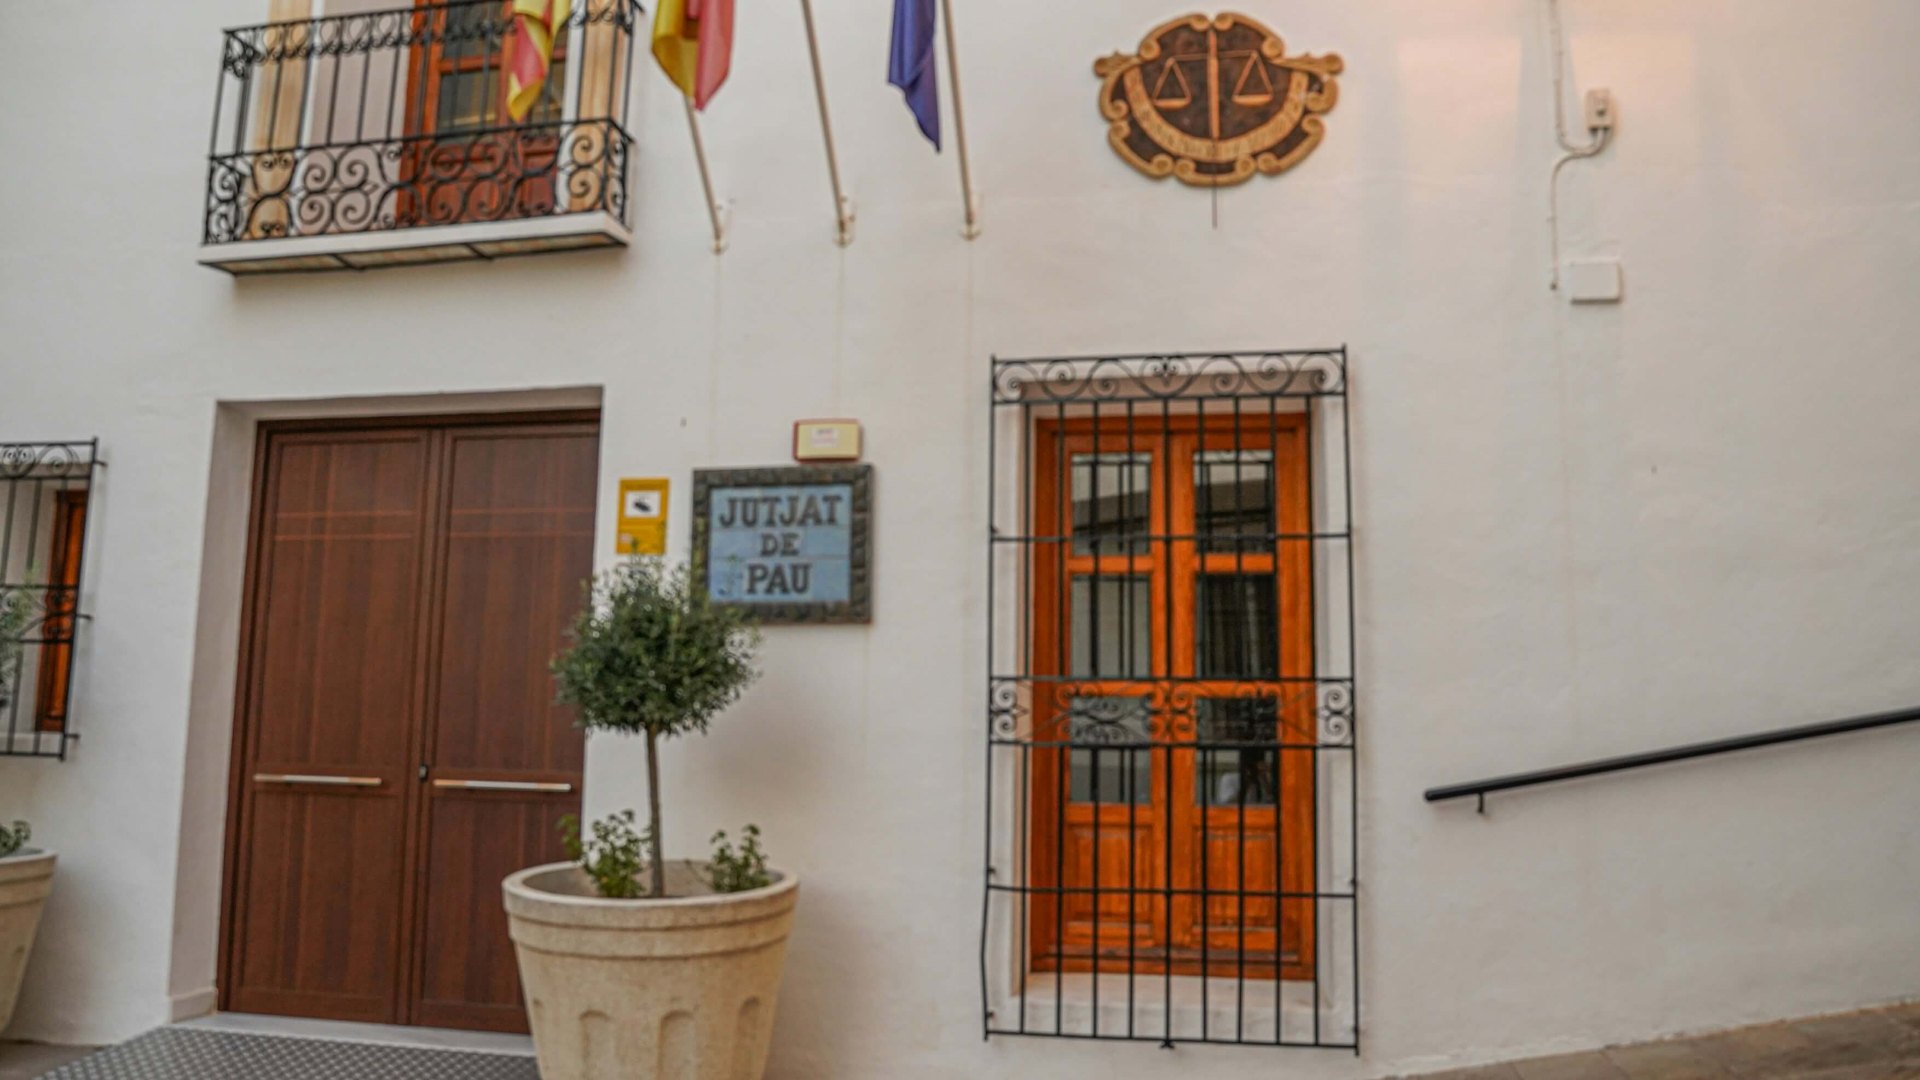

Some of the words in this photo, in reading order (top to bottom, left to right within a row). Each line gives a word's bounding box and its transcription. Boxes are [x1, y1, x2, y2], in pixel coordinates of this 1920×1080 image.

[719, 495, 842, 528] JUTJAT
[761, 533, 800, 557] DE
[747, 564, 812, 595] PAU
